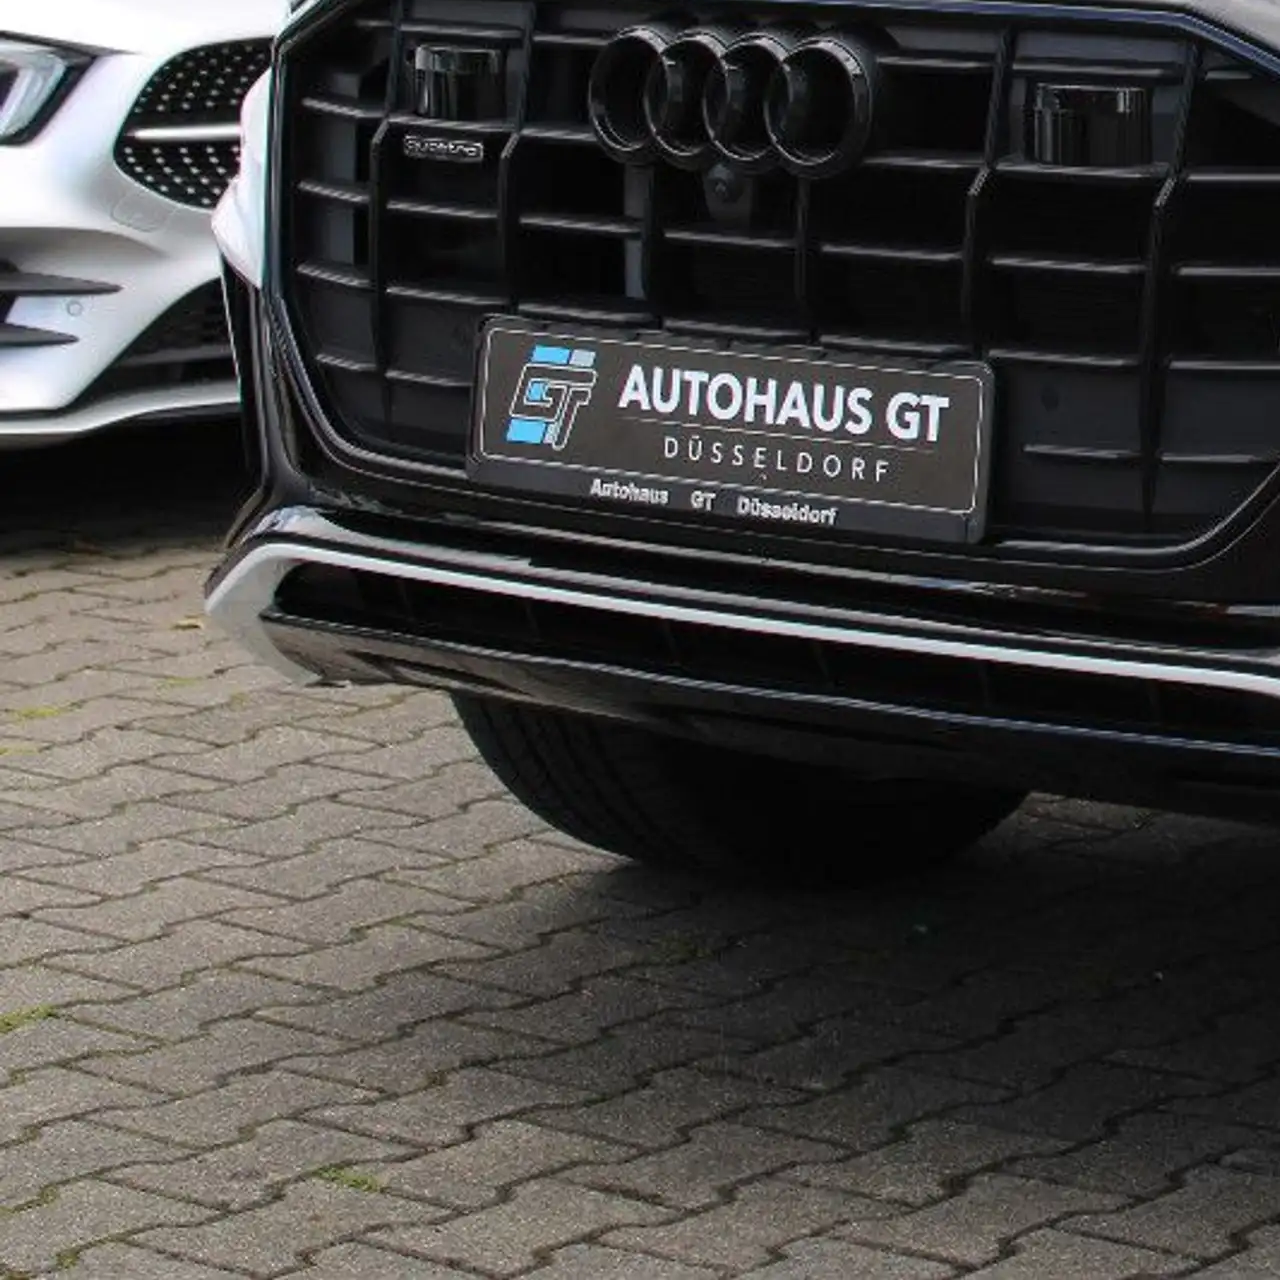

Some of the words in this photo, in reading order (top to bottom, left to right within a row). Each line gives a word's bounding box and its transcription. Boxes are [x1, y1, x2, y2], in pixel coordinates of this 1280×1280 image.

[618, 365, 873, 435] AUTOHAUS
[886, 393, 949, 442] GT
[664, 436, 890, 482] DÜSSELDORF
[589, 478, 668, 505] Autohaus
[690, 491, 716, 512] GT
[737, 496, 838, 525] Düsseldorf
